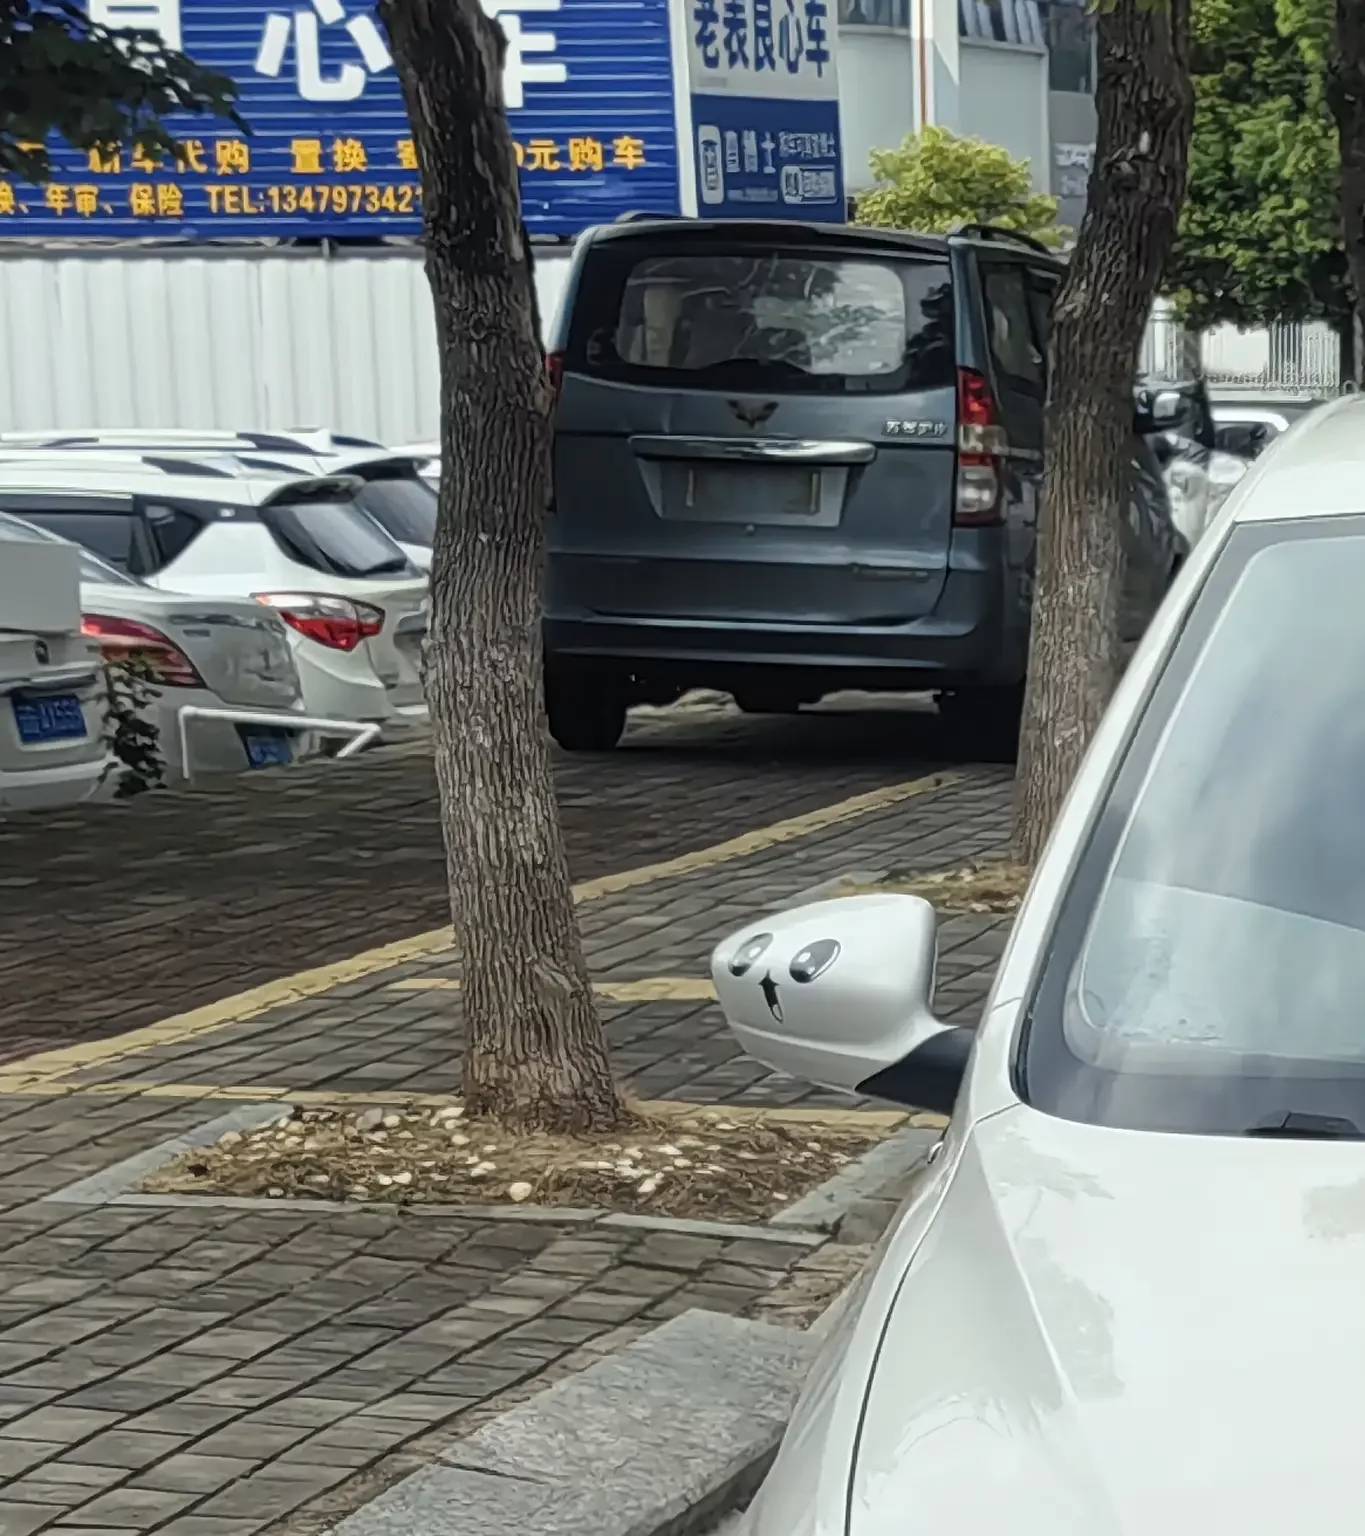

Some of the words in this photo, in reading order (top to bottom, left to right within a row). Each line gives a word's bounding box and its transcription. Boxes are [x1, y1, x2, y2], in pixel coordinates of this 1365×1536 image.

[693, 0, 830, 78] 老表良心车
[290, 138, 368, 173] 置换
